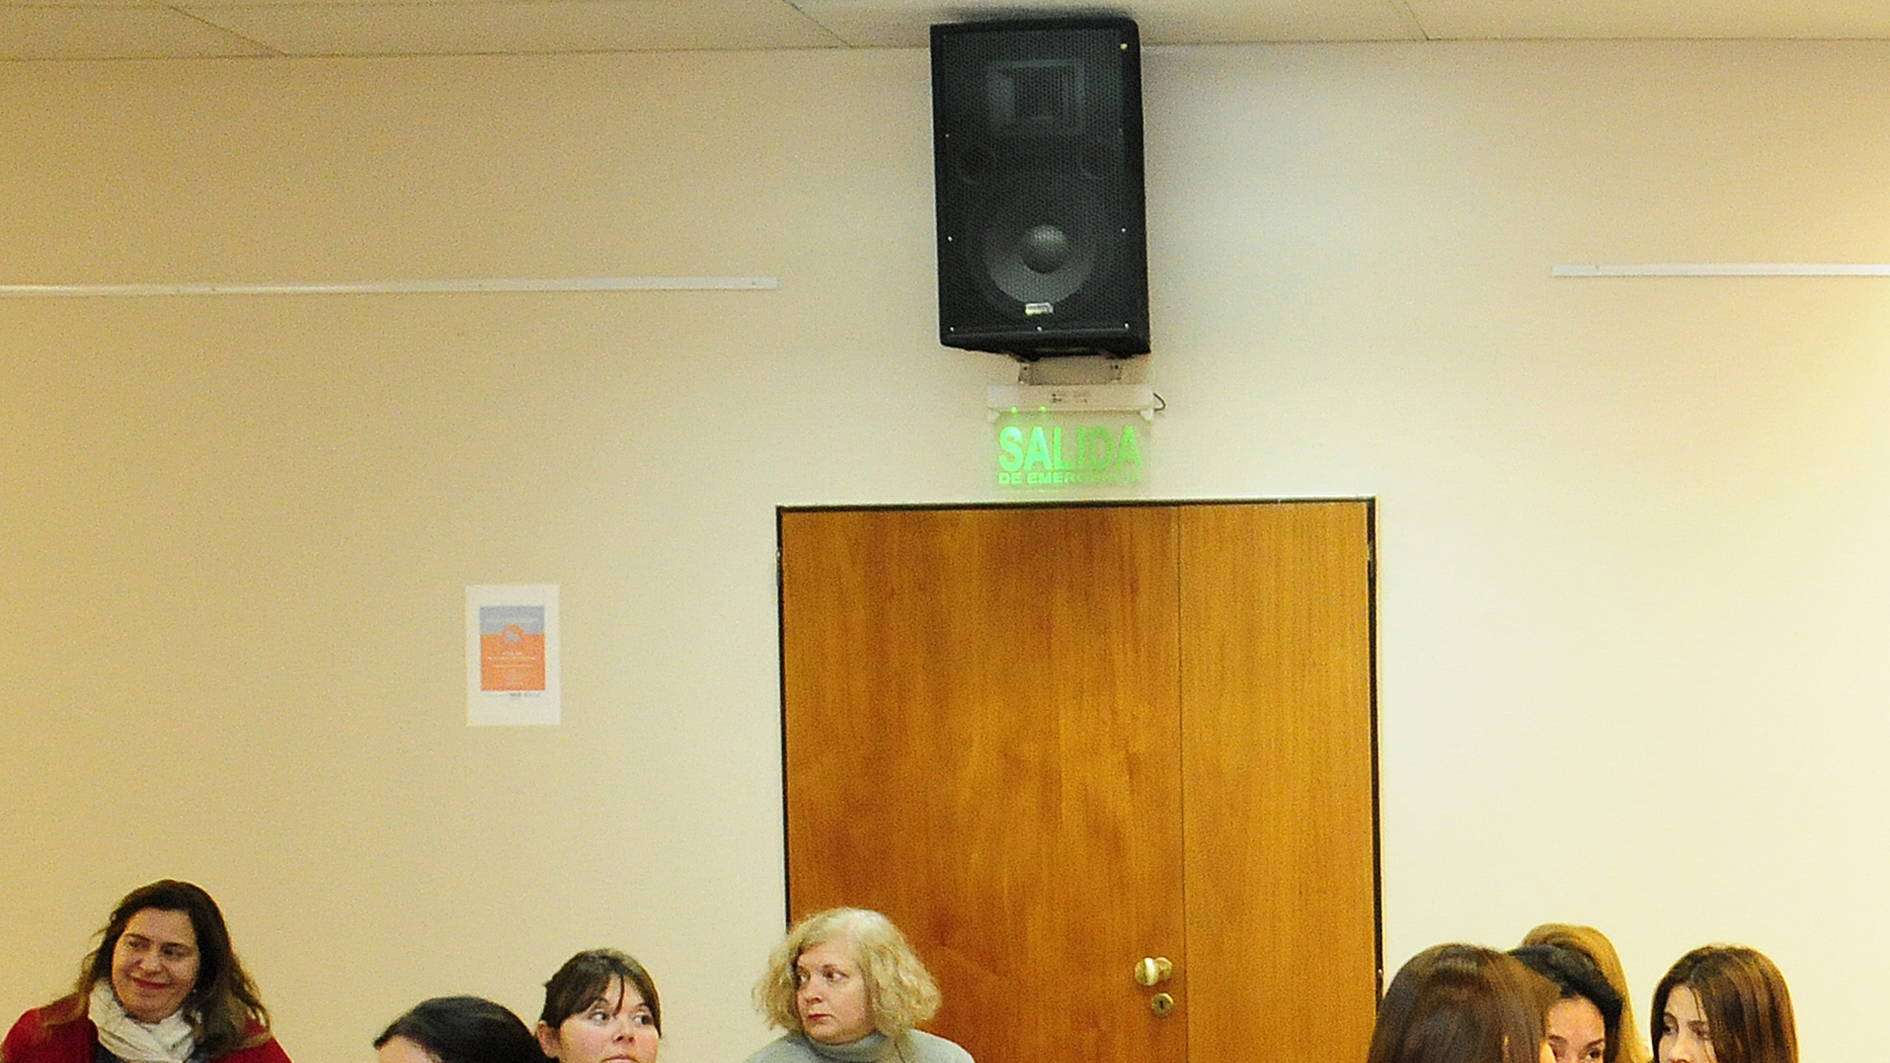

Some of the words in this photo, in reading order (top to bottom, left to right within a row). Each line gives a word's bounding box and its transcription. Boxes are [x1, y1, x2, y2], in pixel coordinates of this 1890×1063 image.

[999, 425, 1142, 472] SALIDA
[998, 471, 1022, 485] DE
[1026, 471, 1140, 485] EMERGA
